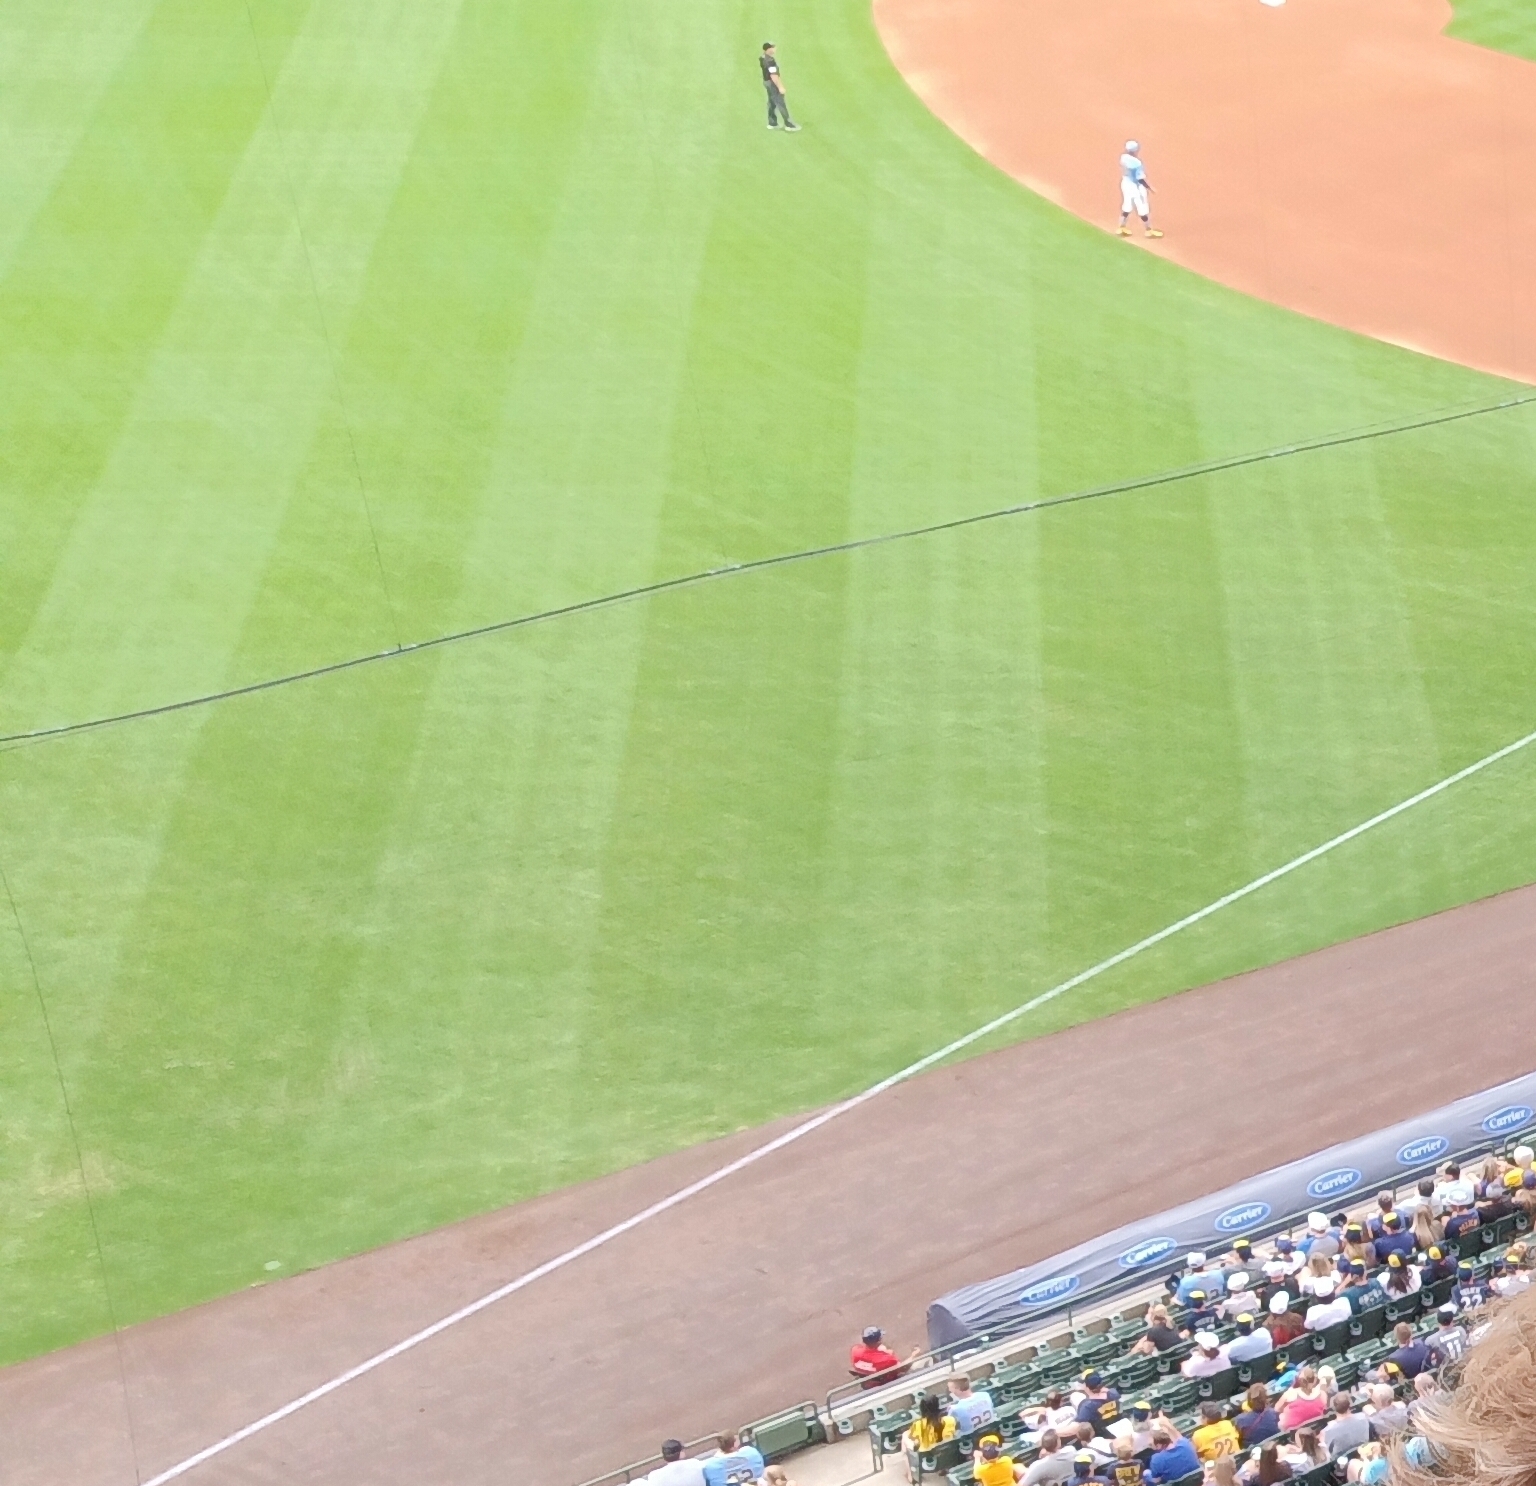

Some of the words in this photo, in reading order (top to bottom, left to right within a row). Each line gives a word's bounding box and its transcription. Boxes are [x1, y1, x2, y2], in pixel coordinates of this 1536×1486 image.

[1486, 1108, 1529, 1129] Carrier
[1402, 1139, 1444, 1160] Carrier
[1313, 1172, 1356, 1194] Carrier
[1220, 1206, 1266, 1228] Carrier
[1124, 1240, 1172, 1267] Carrier
